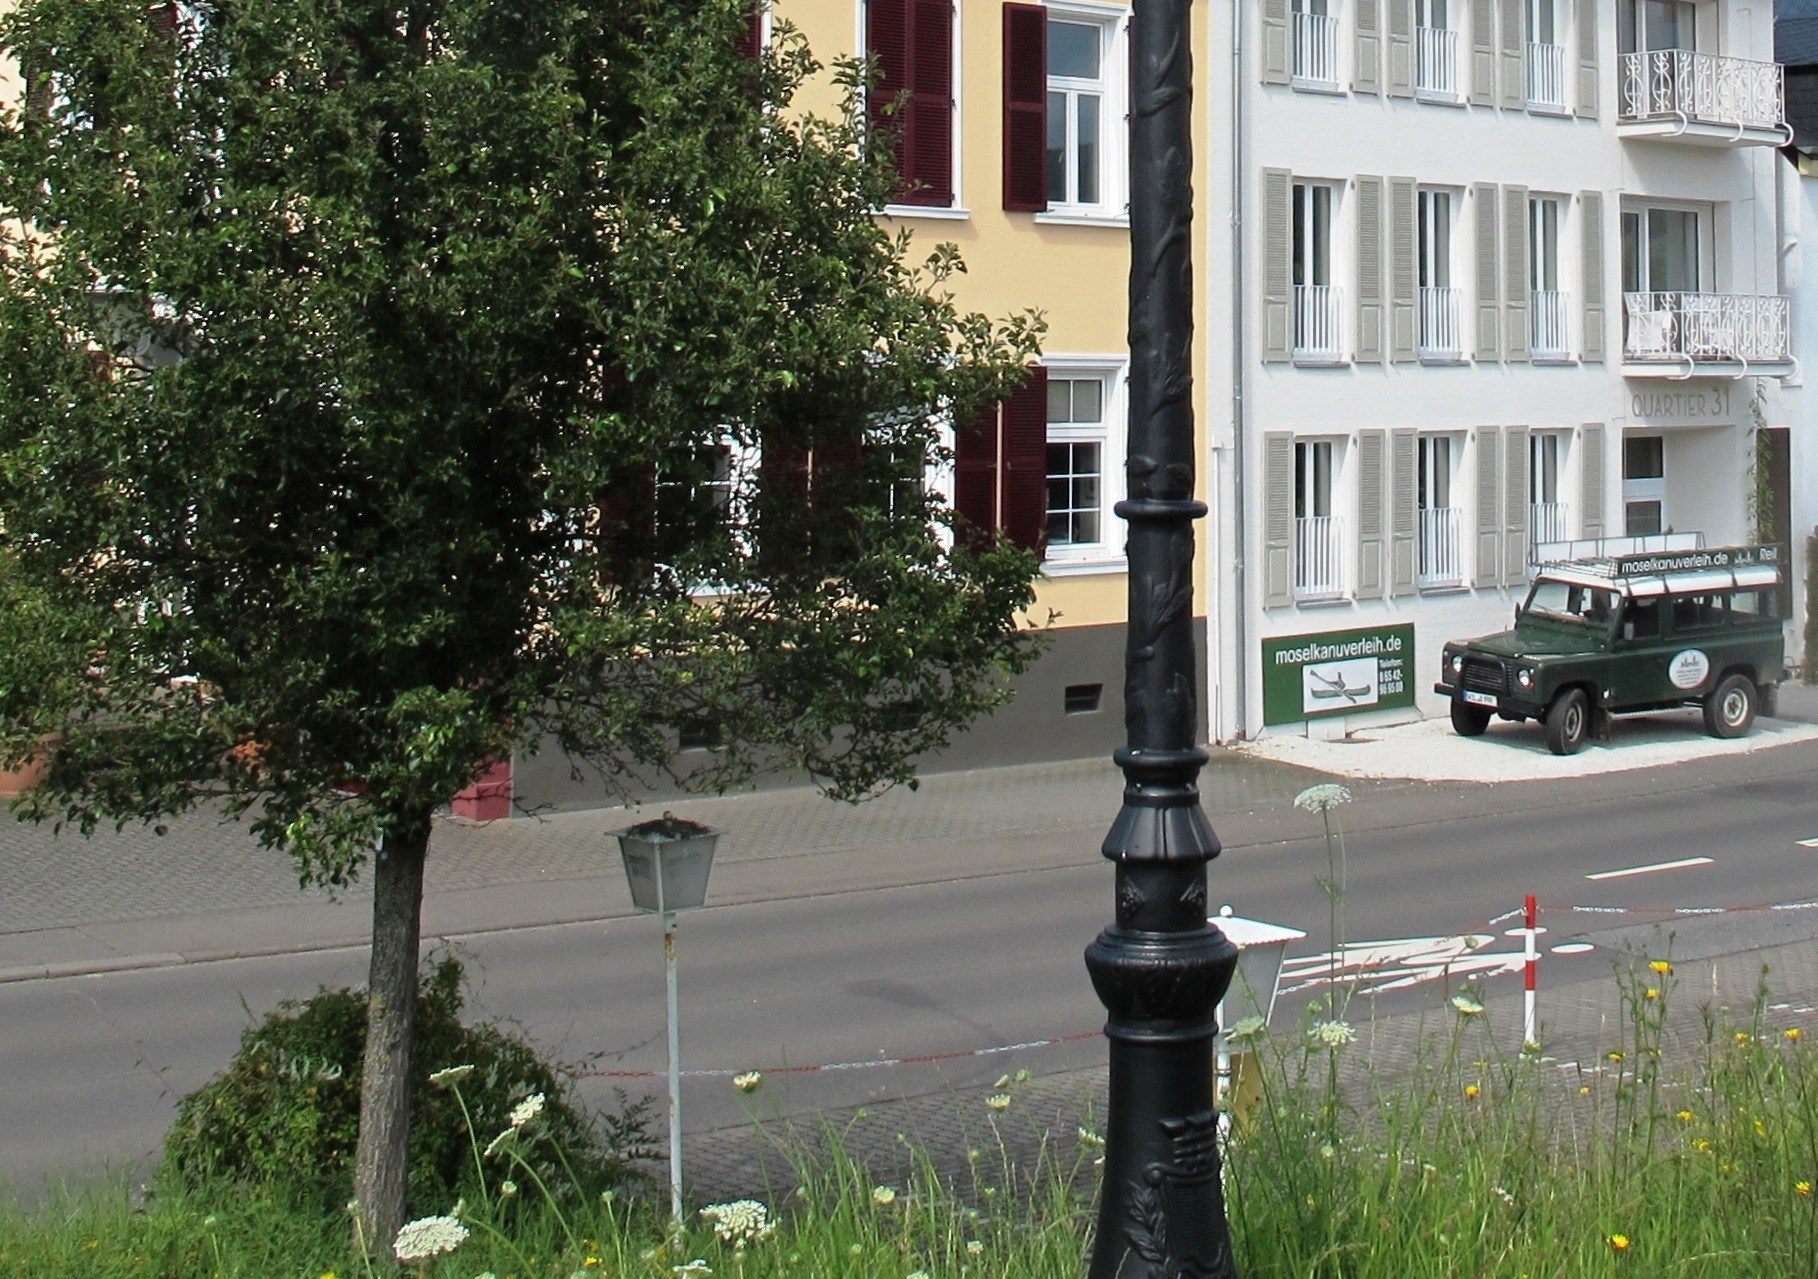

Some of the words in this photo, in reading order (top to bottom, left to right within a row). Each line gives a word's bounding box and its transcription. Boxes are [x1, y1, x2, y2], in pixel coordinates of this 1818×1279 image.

[1711, 386, 1730, 417] 31
[1621, 551, 1728, 574] moselkanuverleih.de
[1759, 547, 1778, 561] Reil
[1275, 634, 1402, 665] moselkanuverleih.de
